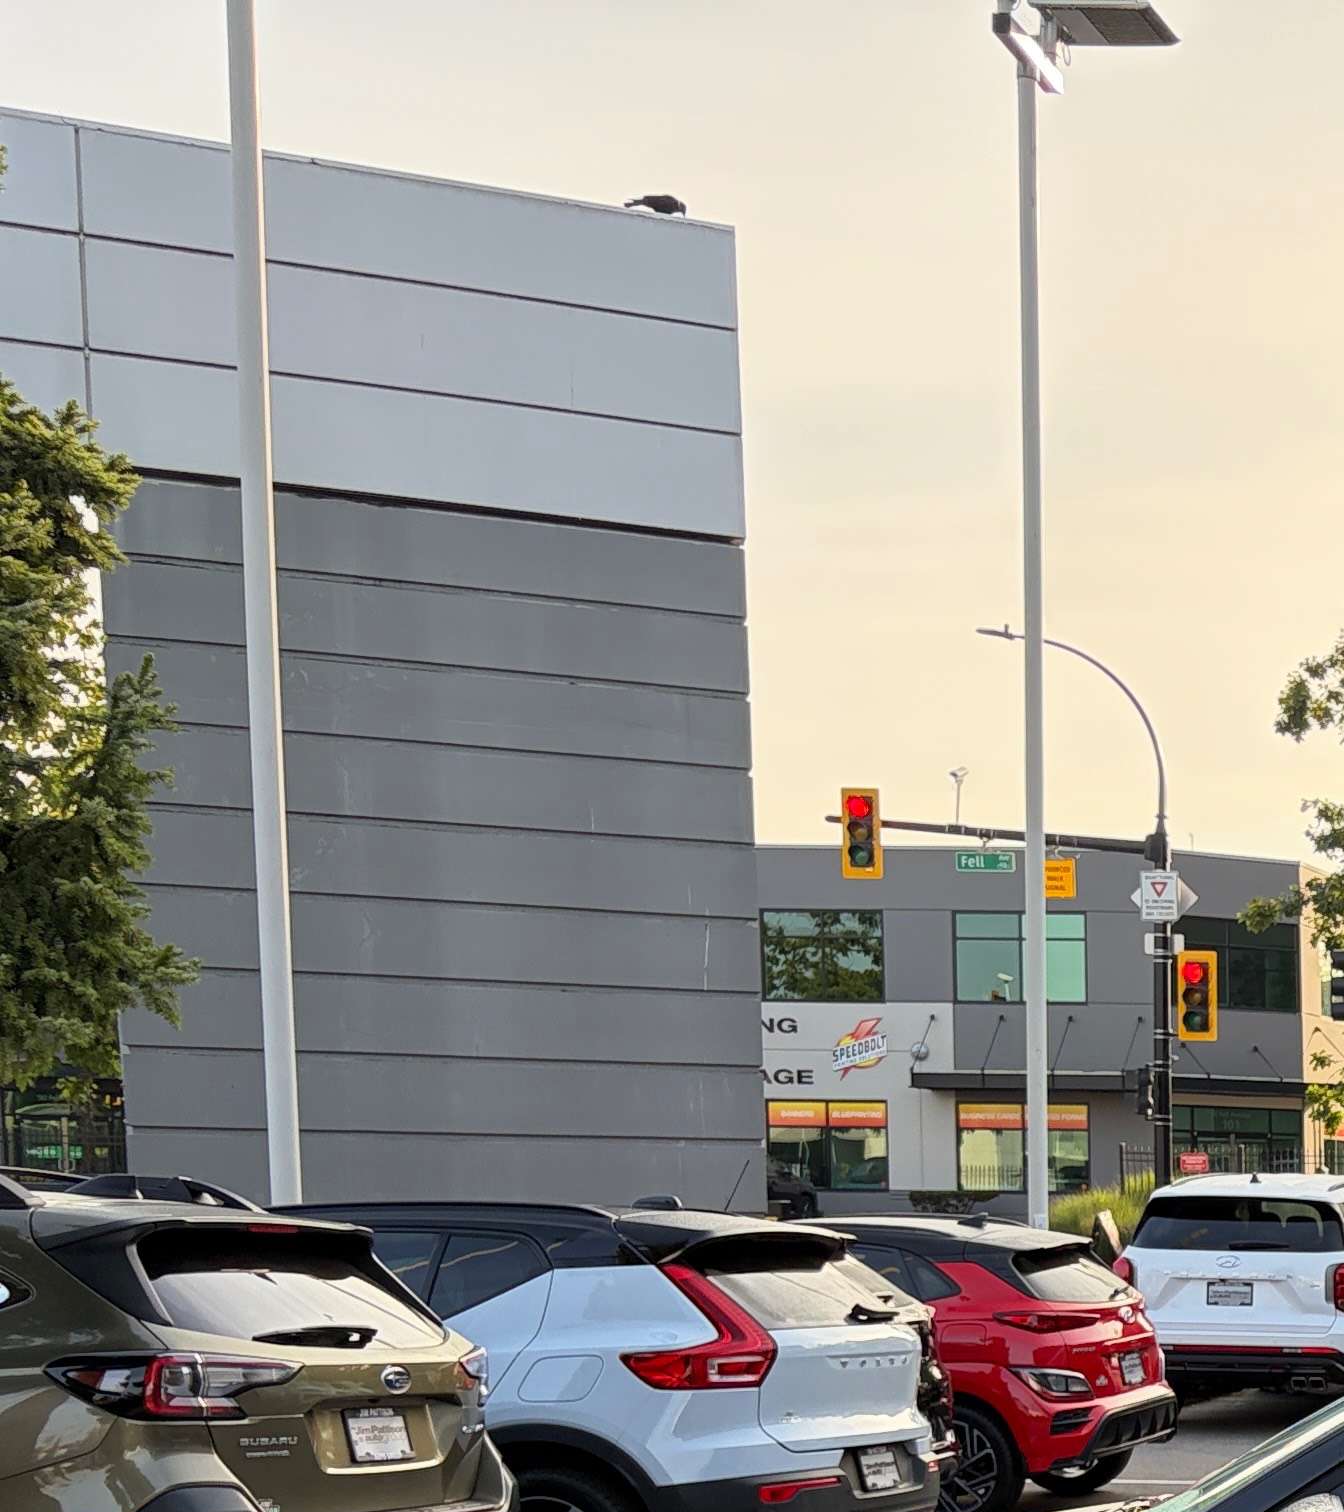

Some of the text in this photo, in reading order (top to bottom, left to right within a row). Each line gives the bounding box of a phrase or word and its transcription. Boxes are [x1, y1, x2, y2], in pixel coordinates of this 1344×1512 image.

[961, 855, 985, 868] Fell
[761, 1018, 798, 1034] NG
[832, 1035, 887, 1063] SPEEDBOLT
[239, 1436, 298, 1447] SUBARU
